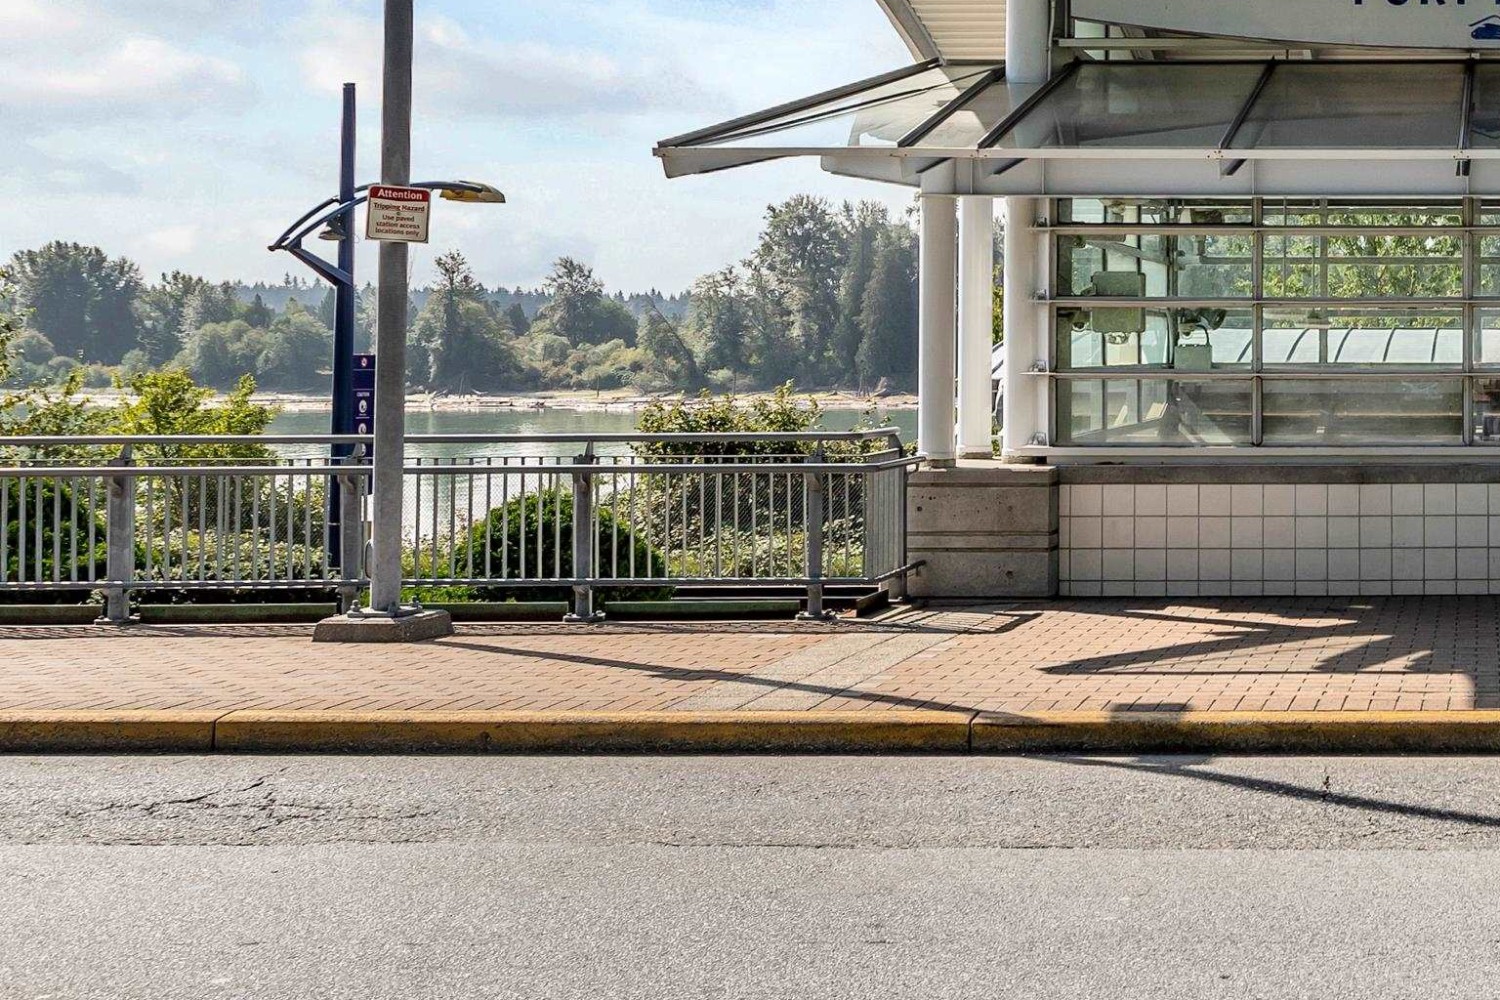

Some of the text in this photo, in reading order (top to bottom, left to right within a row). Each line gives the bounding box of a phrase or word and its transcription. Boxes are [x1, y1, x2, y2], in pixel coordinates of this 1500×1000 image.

[377, 189, 422, 200] Attention
[373, 202, 425, 212] Tripping Hazard
[376, 220, 398, 228] station
[375, 227, 420, 237] locations only
